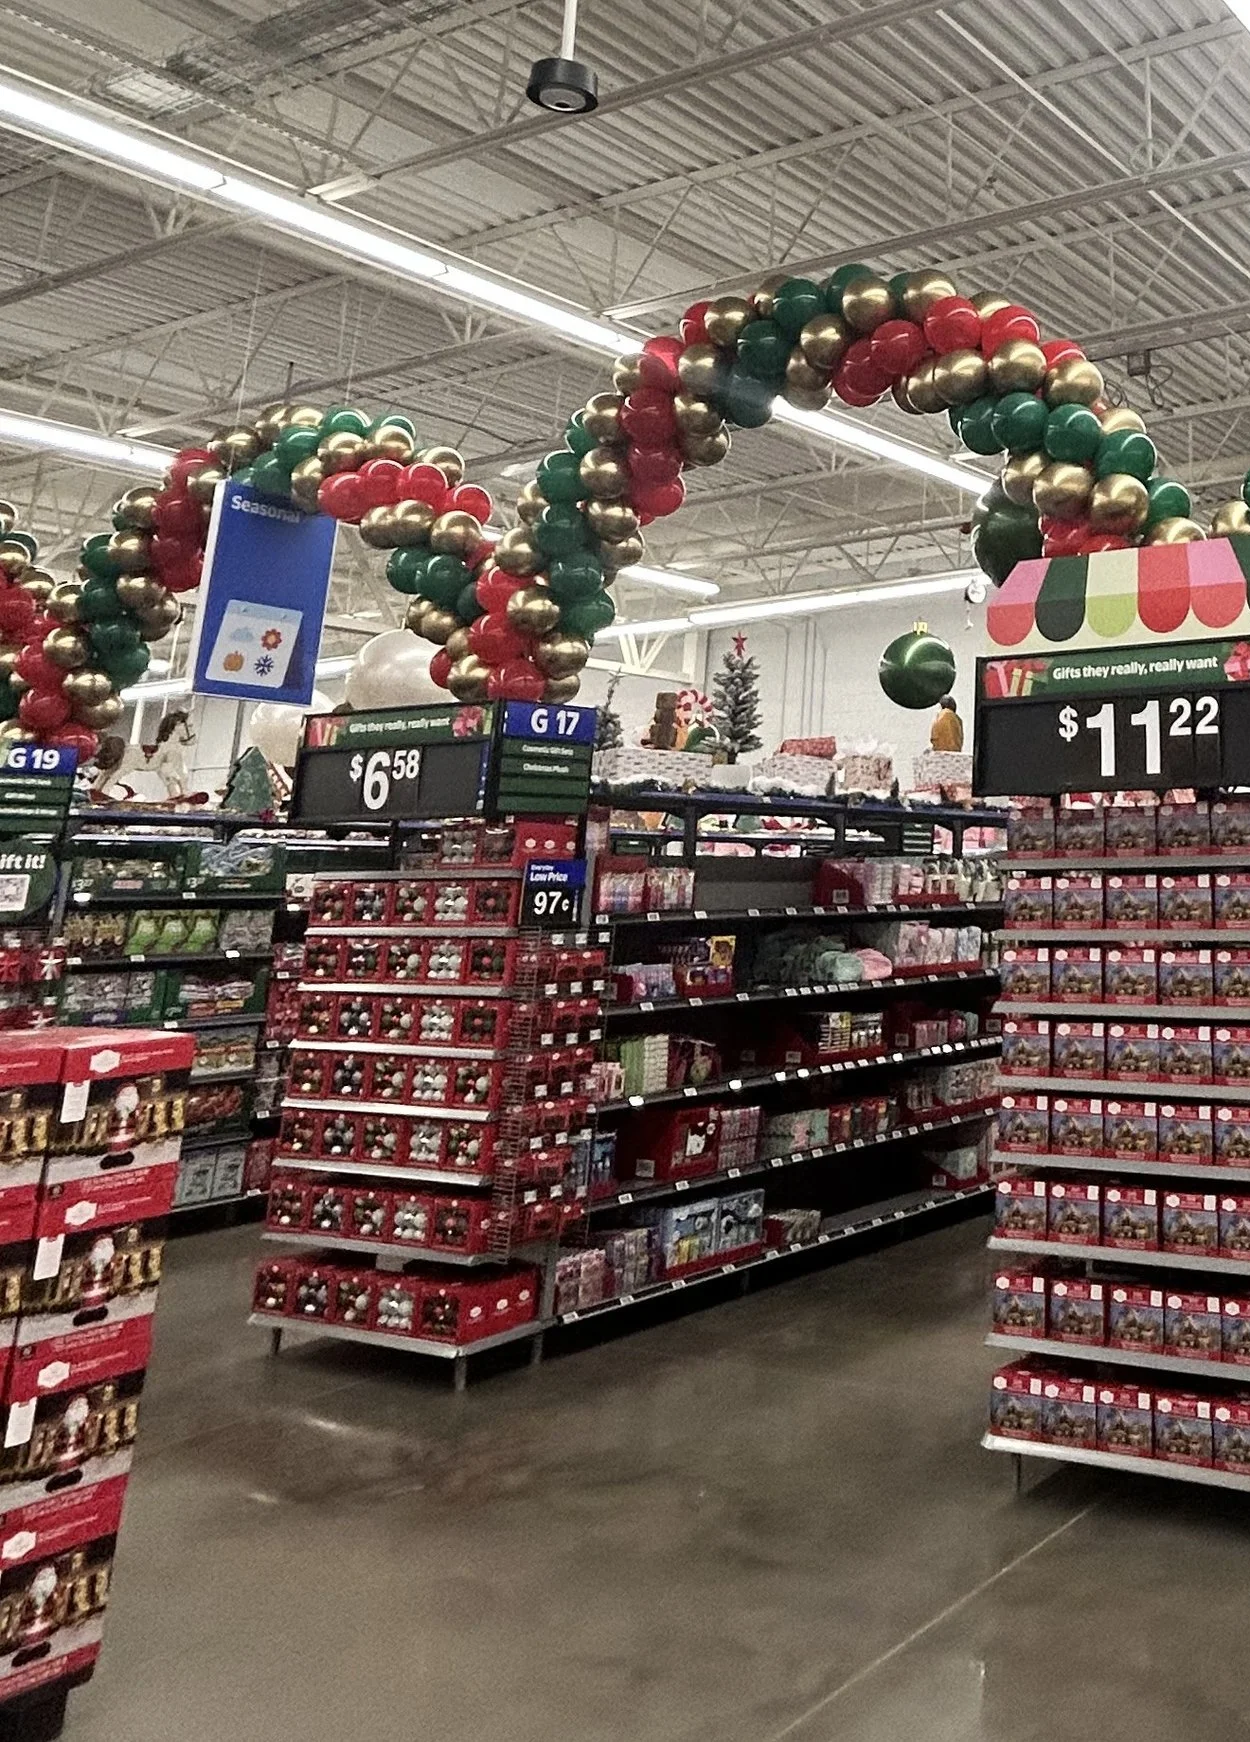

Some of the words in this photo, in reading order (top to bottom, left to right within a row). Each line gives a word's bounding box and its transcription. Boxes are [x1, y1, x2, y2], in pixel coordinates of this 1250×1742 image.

[1052, 667, 1081, 680] Gifts
[1082, 665, 1110, 679] they
[1111, 661, 1148, 675] really,
[1149, 658, 1184, 672] really
[1185, 656, 1218, 669] want
[349, 722, 367, 734] Gifts
[367, 722, 384, 733] they
[407, 717, 429, 730] really
[429, 716, 450, 728] want
[531, 708, 549, 734] G
[556, 710, 580, 736] 17
[7, 747, 27, 769] G
[31, 748, 61, 770] 19
[25, 854, 46, 870] it!
[530, 872, 548, 882] Low
[548, 871, 569, 883] Price
